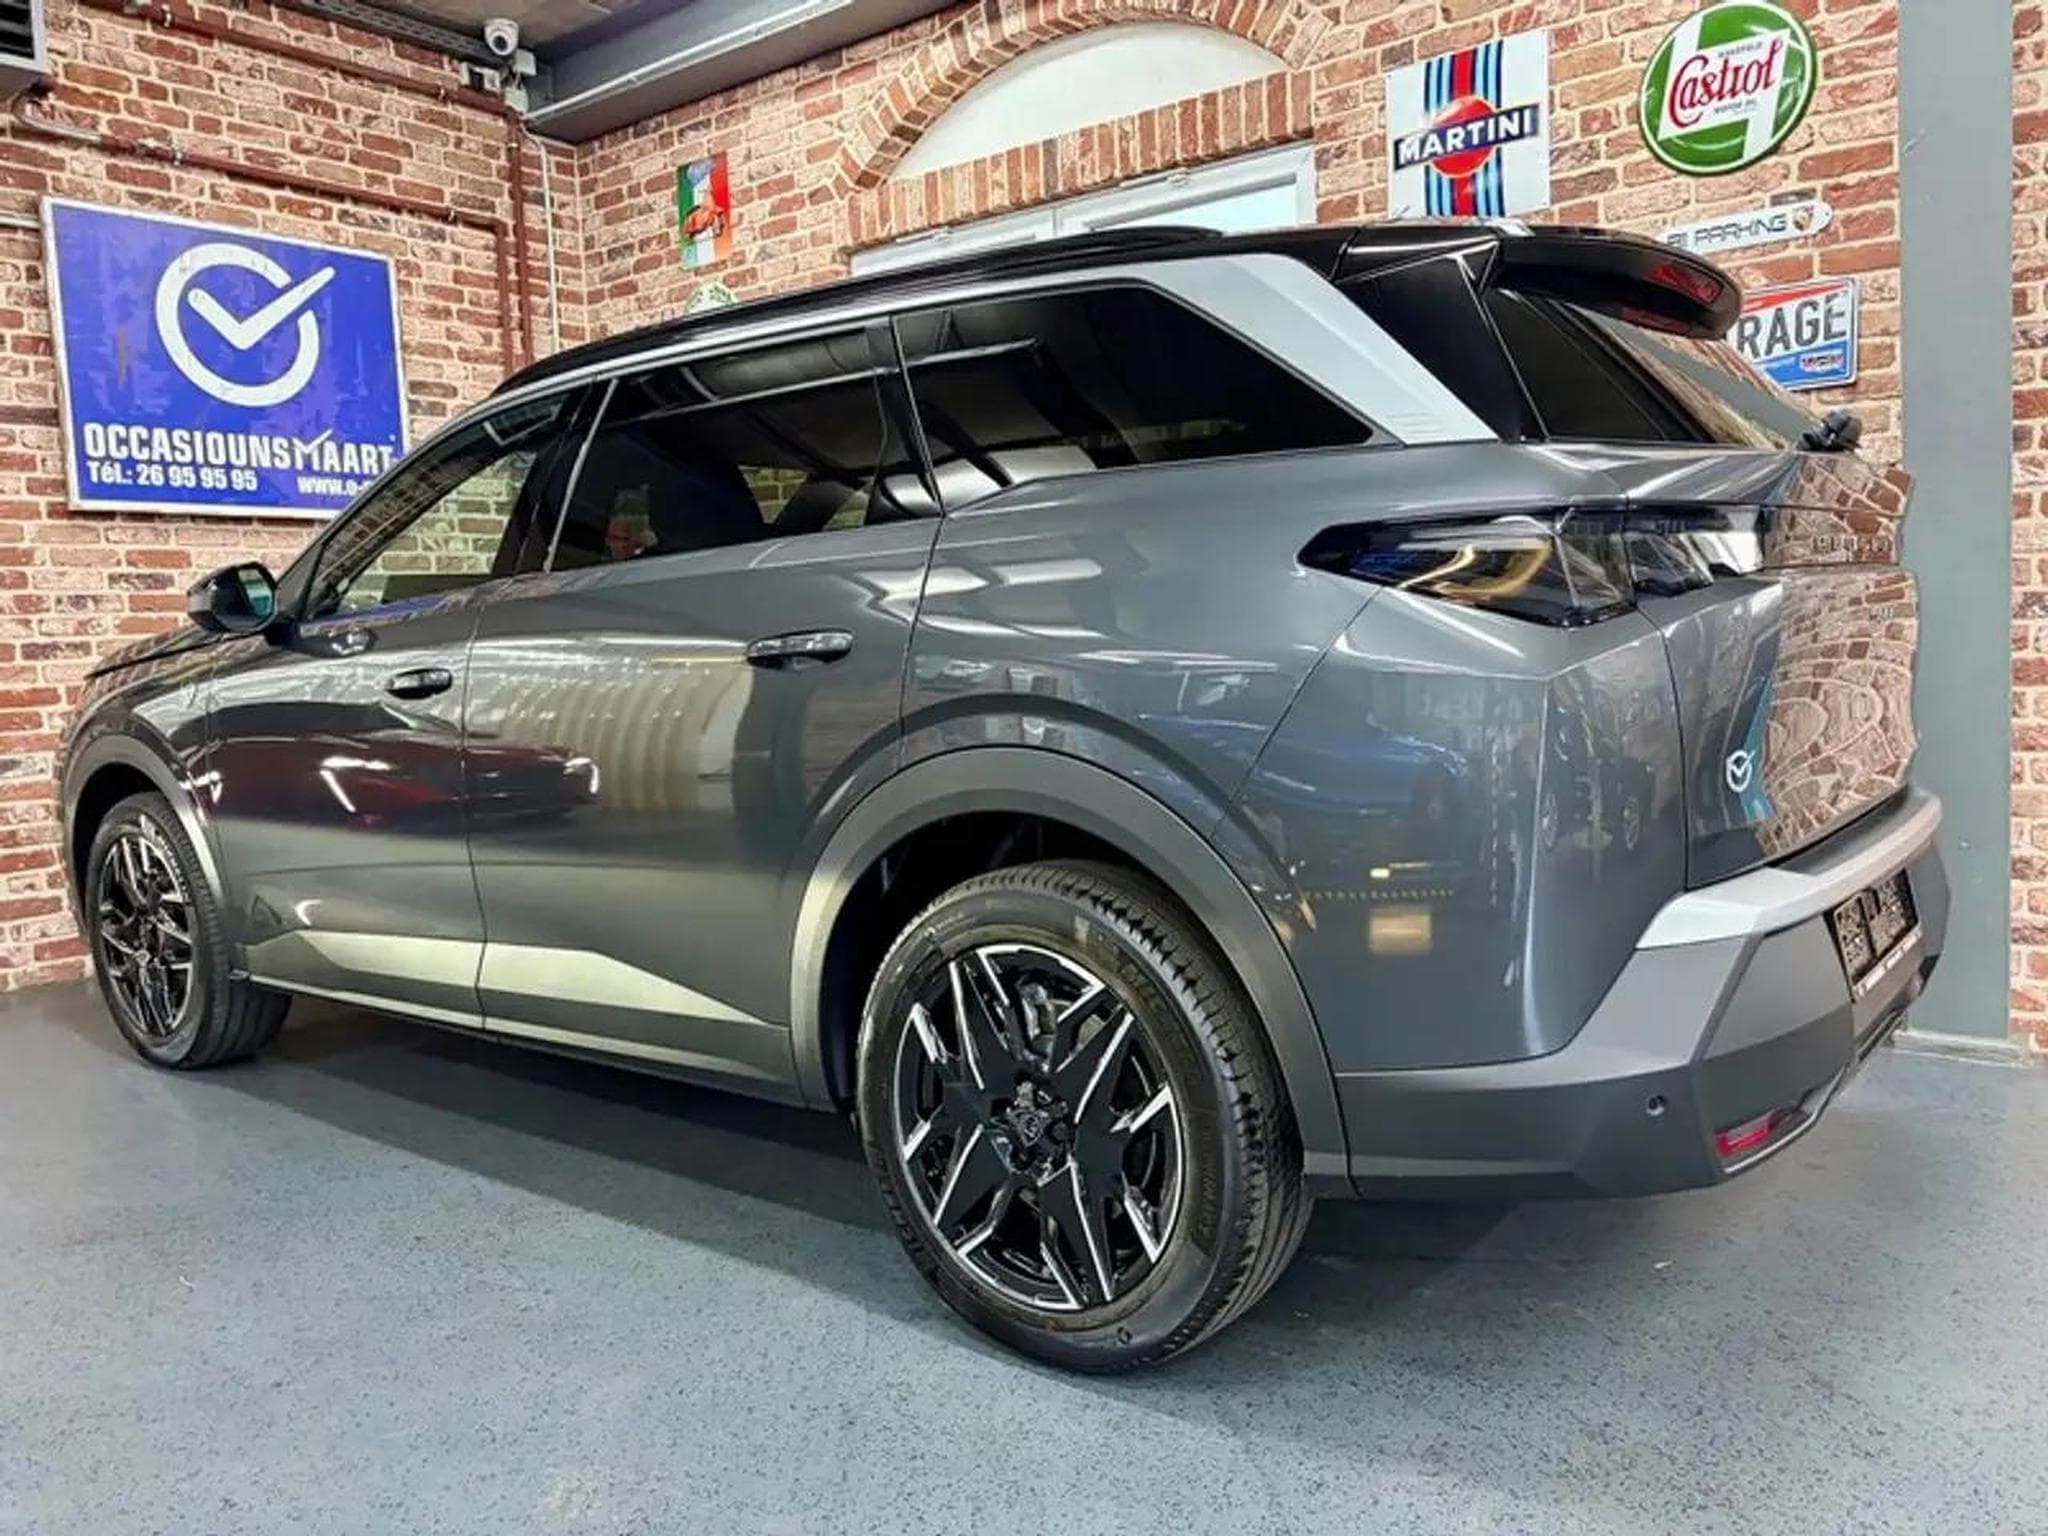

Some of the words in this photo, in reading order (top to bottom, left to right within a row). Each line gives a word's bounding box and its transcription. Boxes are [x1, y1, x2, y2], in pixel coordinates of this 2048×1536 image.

[1669, 38, 1783, 128] Castrol
[1398, 107, 1532, 165] MARTINI
[1736, 290, 1848, 360] RAGE
[83, 421, 393, 475] OCCASIOUNSMAART
[136, 463, 165, 486] 26
[168, 465, 197, 488] 95
[200, 468, 228, 490] 95
[230, 469, 258, 492] 95
